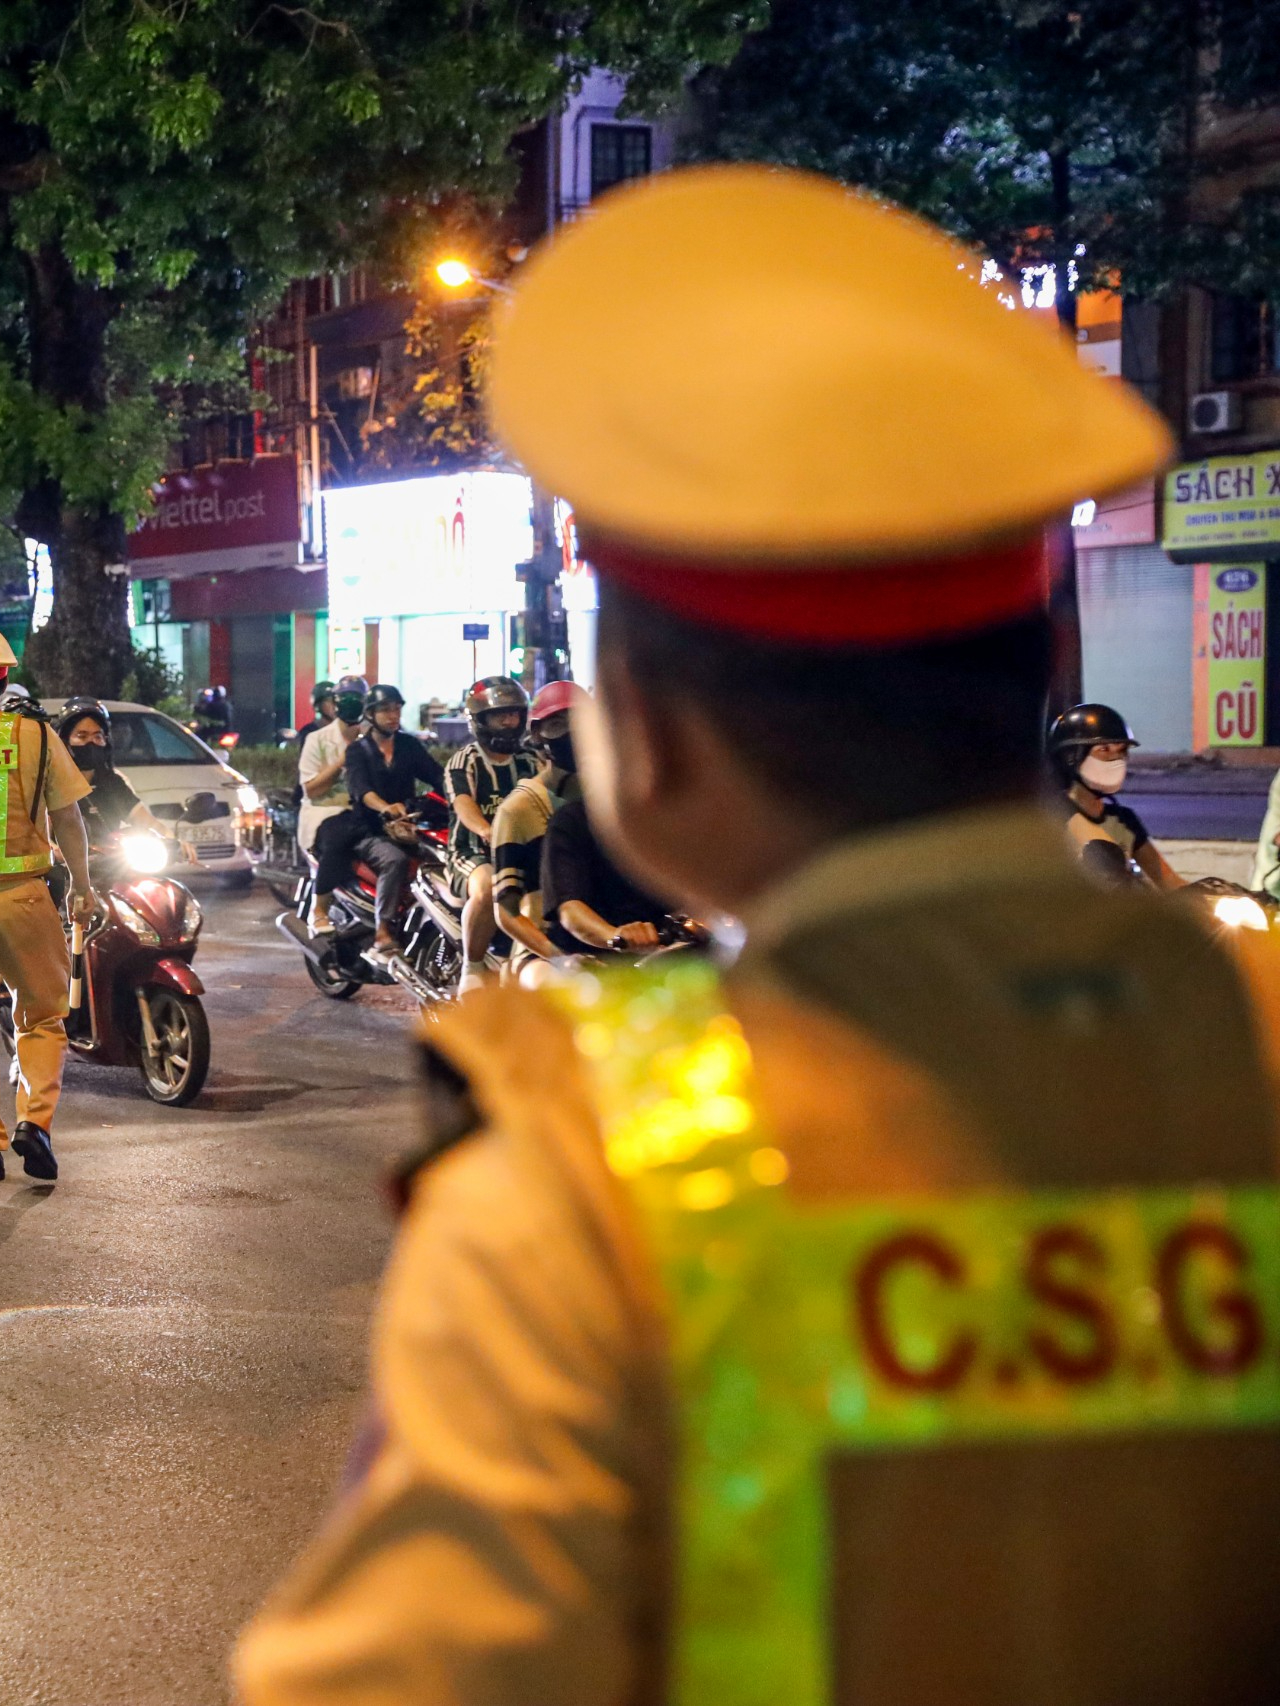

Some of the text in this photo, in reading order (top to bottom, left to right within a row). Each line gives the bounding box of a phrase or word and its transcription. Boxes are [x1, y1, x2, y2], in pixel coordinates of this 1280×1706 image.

[1175, 459, 1254, 503] SÁCH
[223, 491, 266, 526] post
[1212, 600, 1263, 661] SÁCH
[1216, 679, 1258, 740] CŨ
